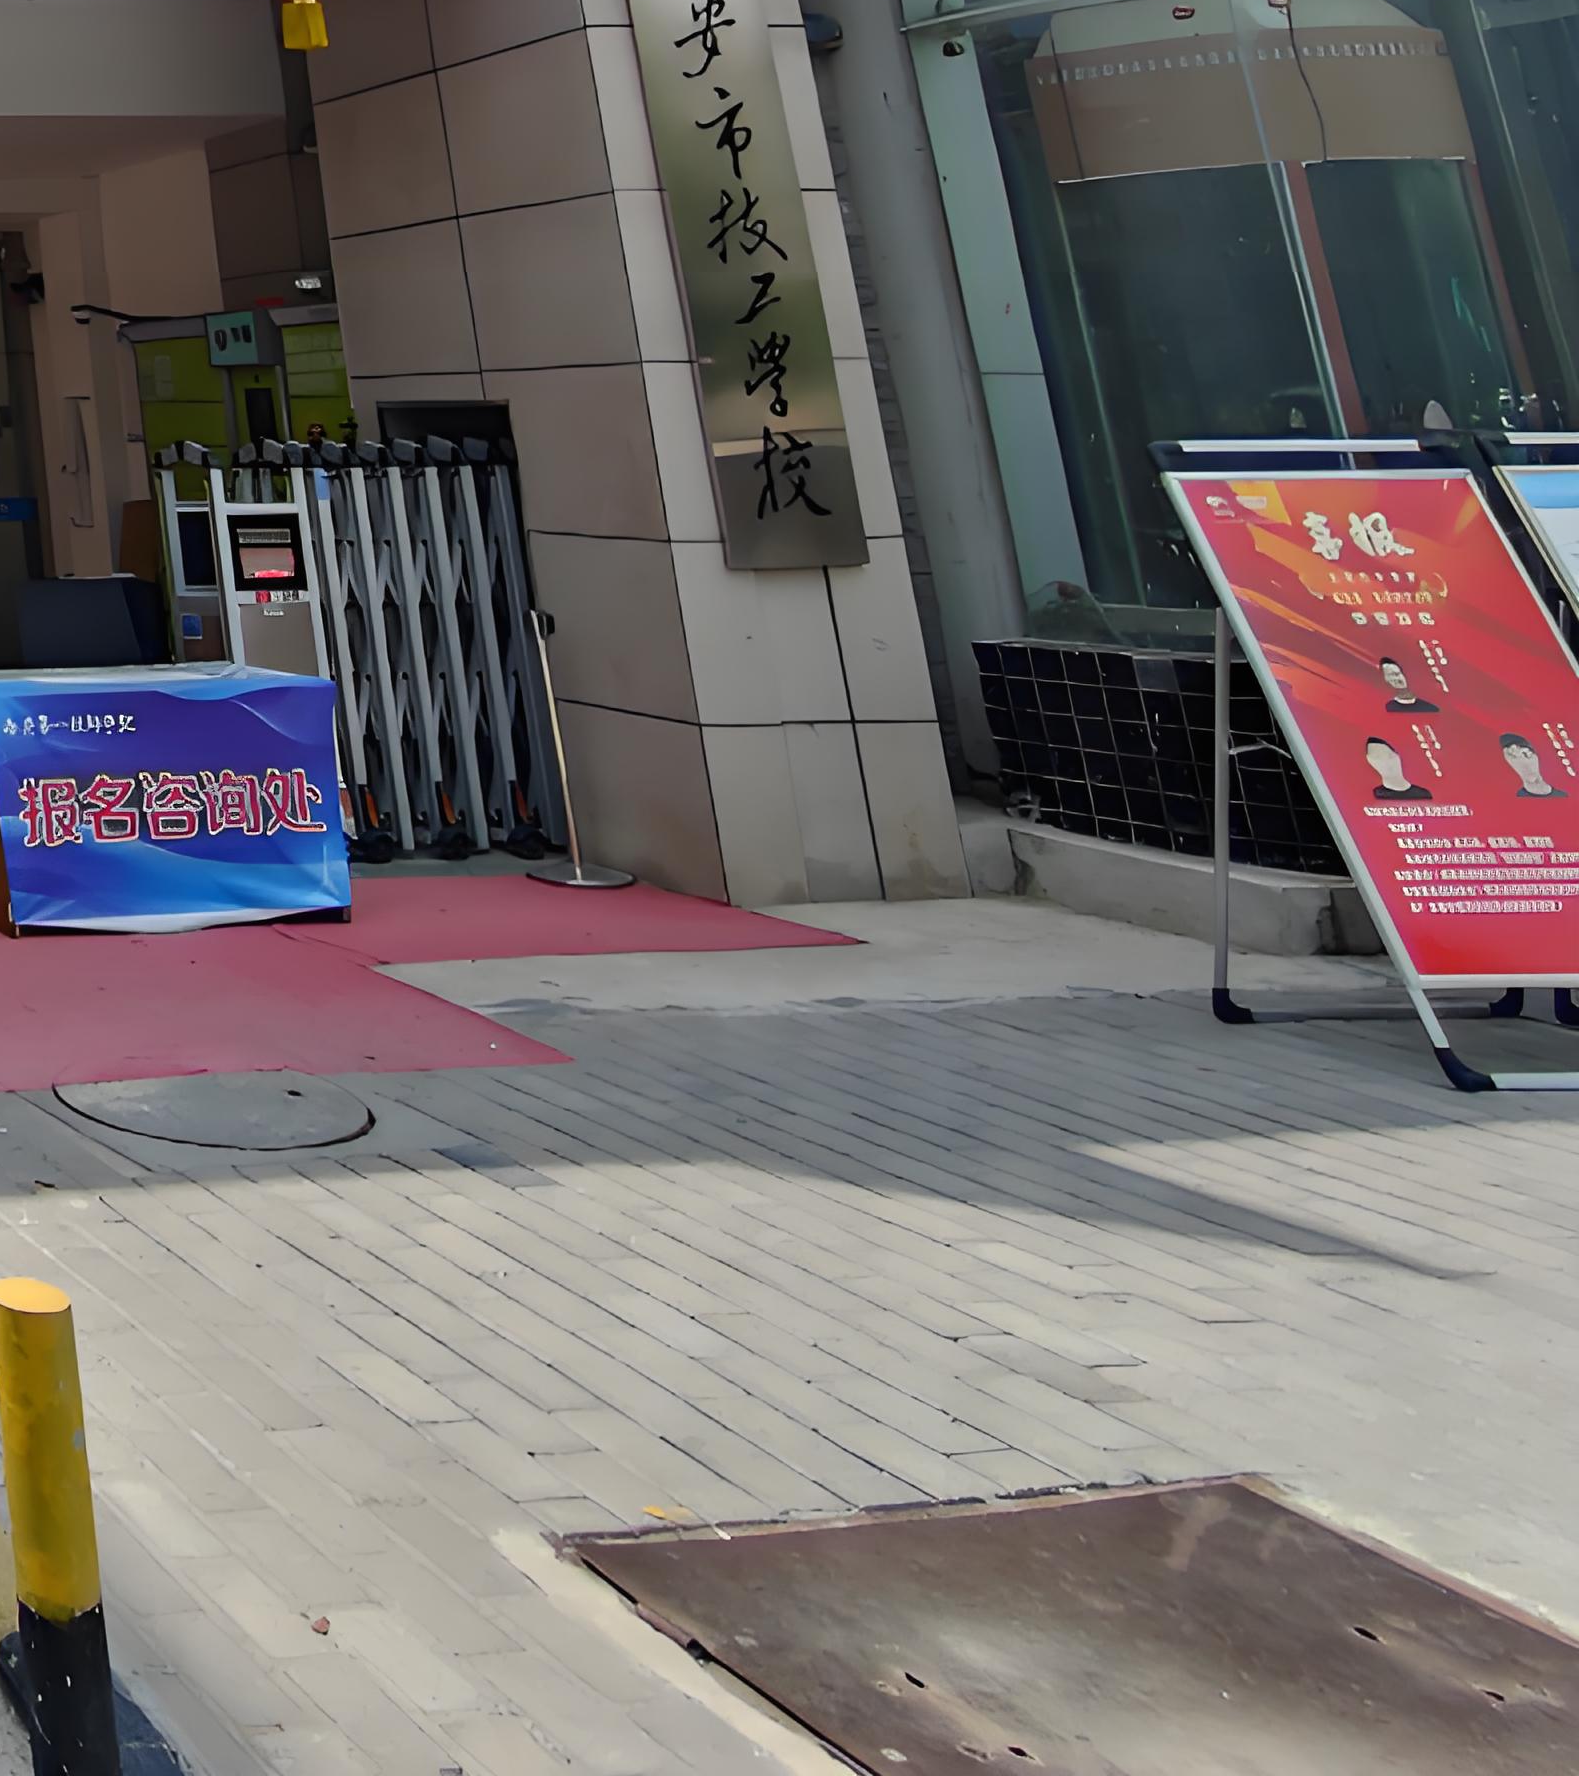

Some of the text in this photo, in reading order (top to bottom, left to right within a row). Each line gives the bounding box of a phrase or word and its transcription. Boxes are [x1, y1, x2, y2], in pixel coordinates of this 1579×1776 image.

[17, 767, 329, 848] 报名咨询处
